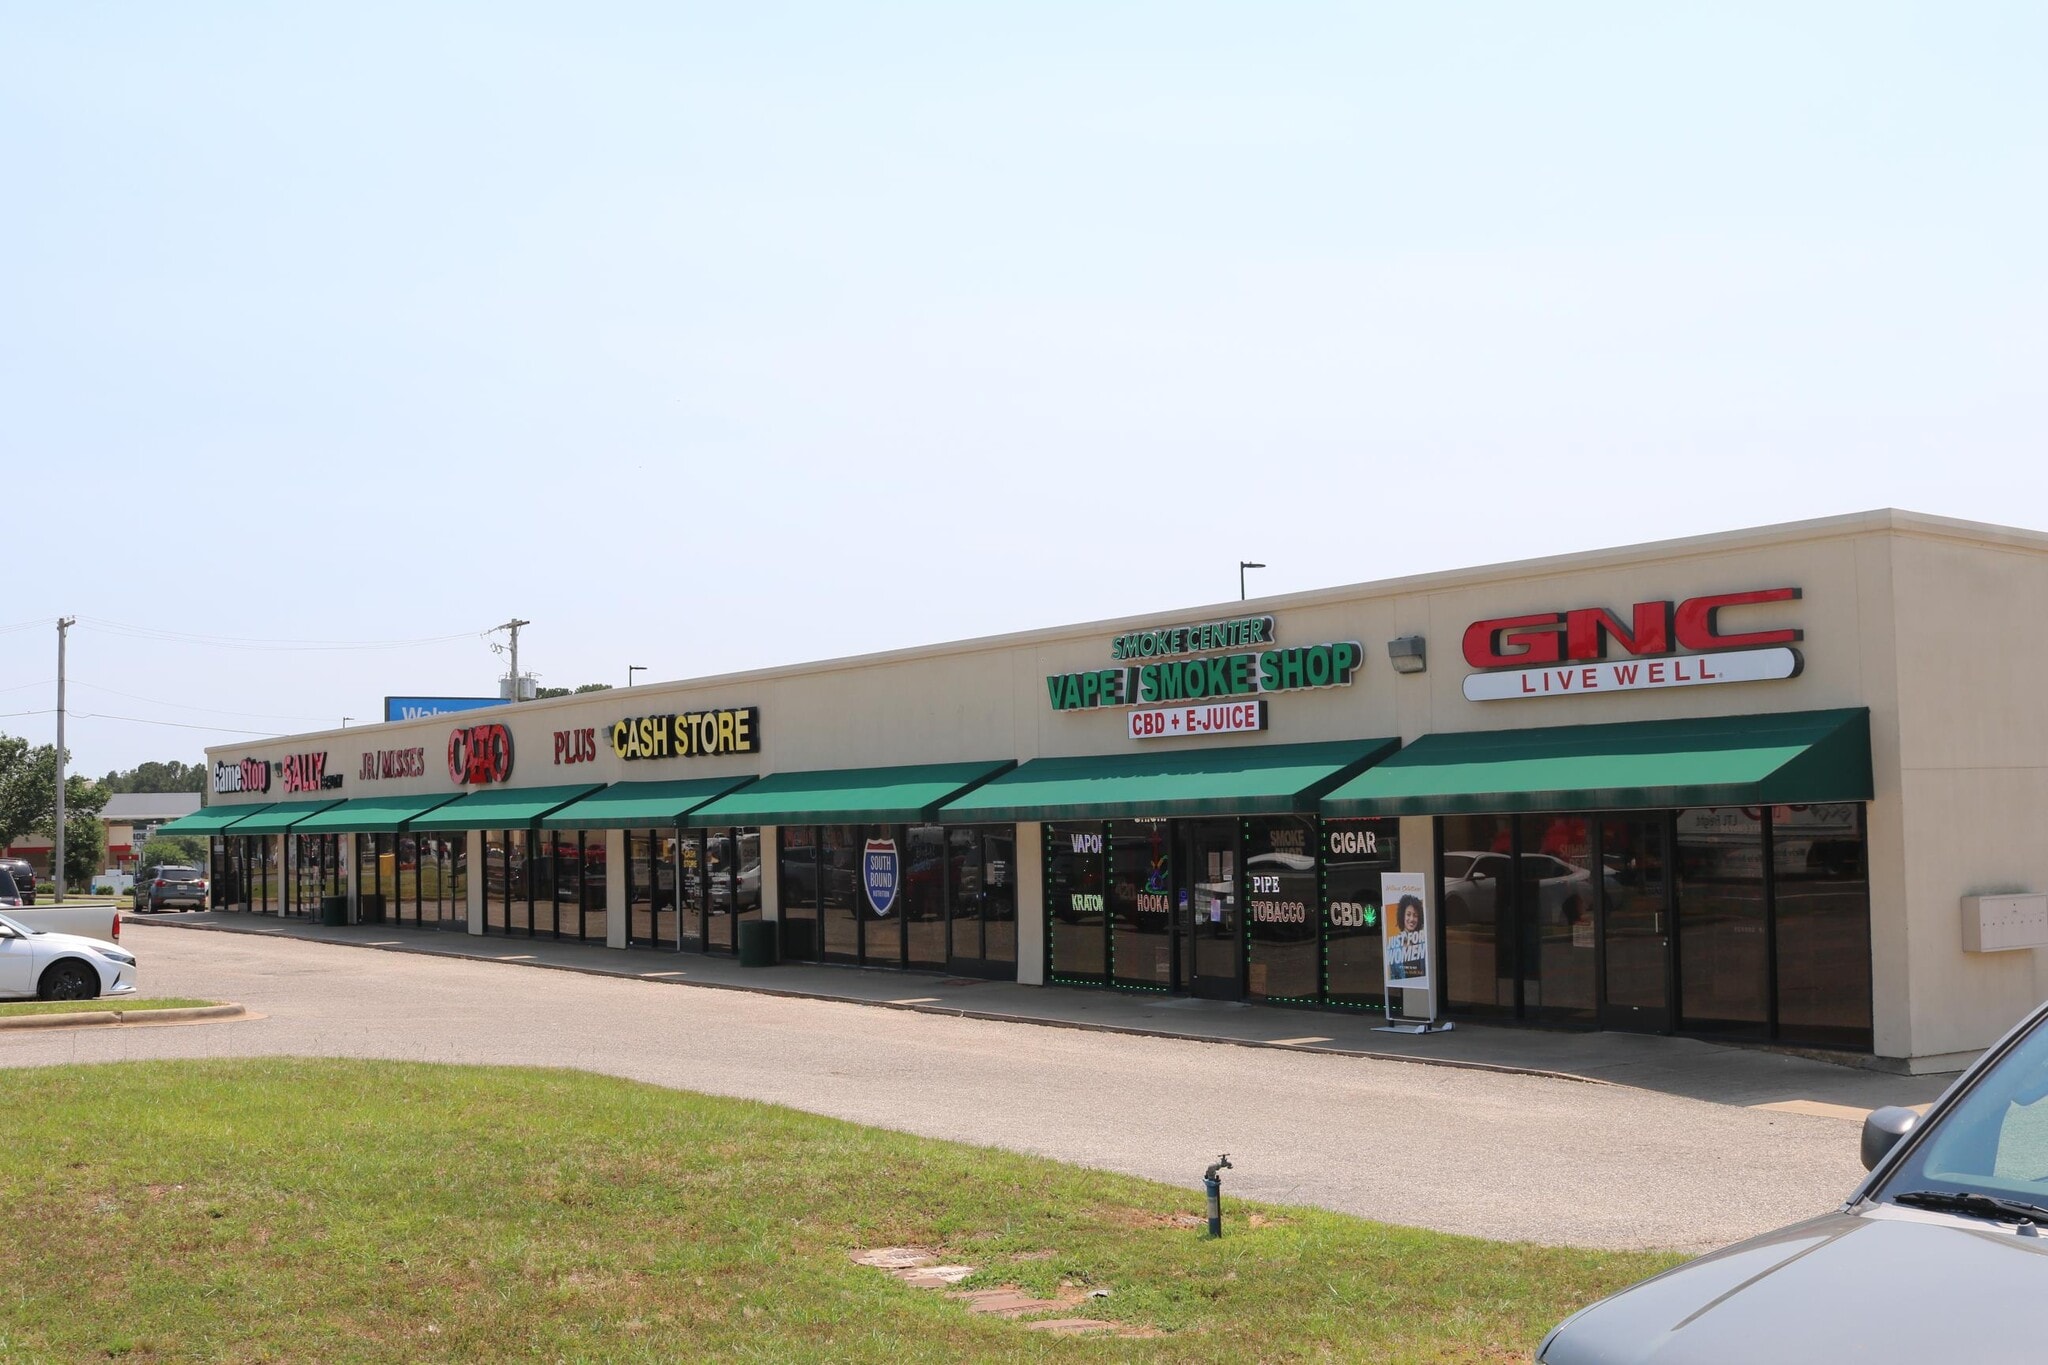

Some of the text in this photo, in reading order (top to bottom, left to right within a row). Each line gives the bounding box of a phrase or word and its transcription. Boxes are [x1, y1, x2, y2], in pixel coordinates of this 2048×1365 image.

[1111, 618, 1266, 660] SMOKE CENTER
[1462, 588, 1803, 668] GNC
[1047, 670, 1117, 711] VAPE
[1140, 655, 1250, 702] SMOKE
[1260, 642, 1354, 691] SHOP
[1521, 666, 1597, 694] LIVE
[1132, 711, 1166, 736] CBD
[1186, 704, 1256, 733] E-JUICE
[613, 709, 751, 759] CASH STORE
[448, 724, 511, 785] CATO
[553, 728, 597, 765] PLUS
[213, 758, 269, 794] GameStop
[283, 752, 326, 793] SALLY
[1270, 829, 1306, 847] SMOKE
[1330, 831, 1378, 854] CIGAR
[870, 855, 891, 871] SOUTH
[870, 872, 892, 888] BOUND
[1252, 876, 1280, 894] PIPE
[1251, 900, 1306, 924] TOBACCO
[1330, 900, 1363, 927] CBD
[1387, 929, 1426, 950] JUST FOR
[1387, 944, 1426, 967] WOMEN
